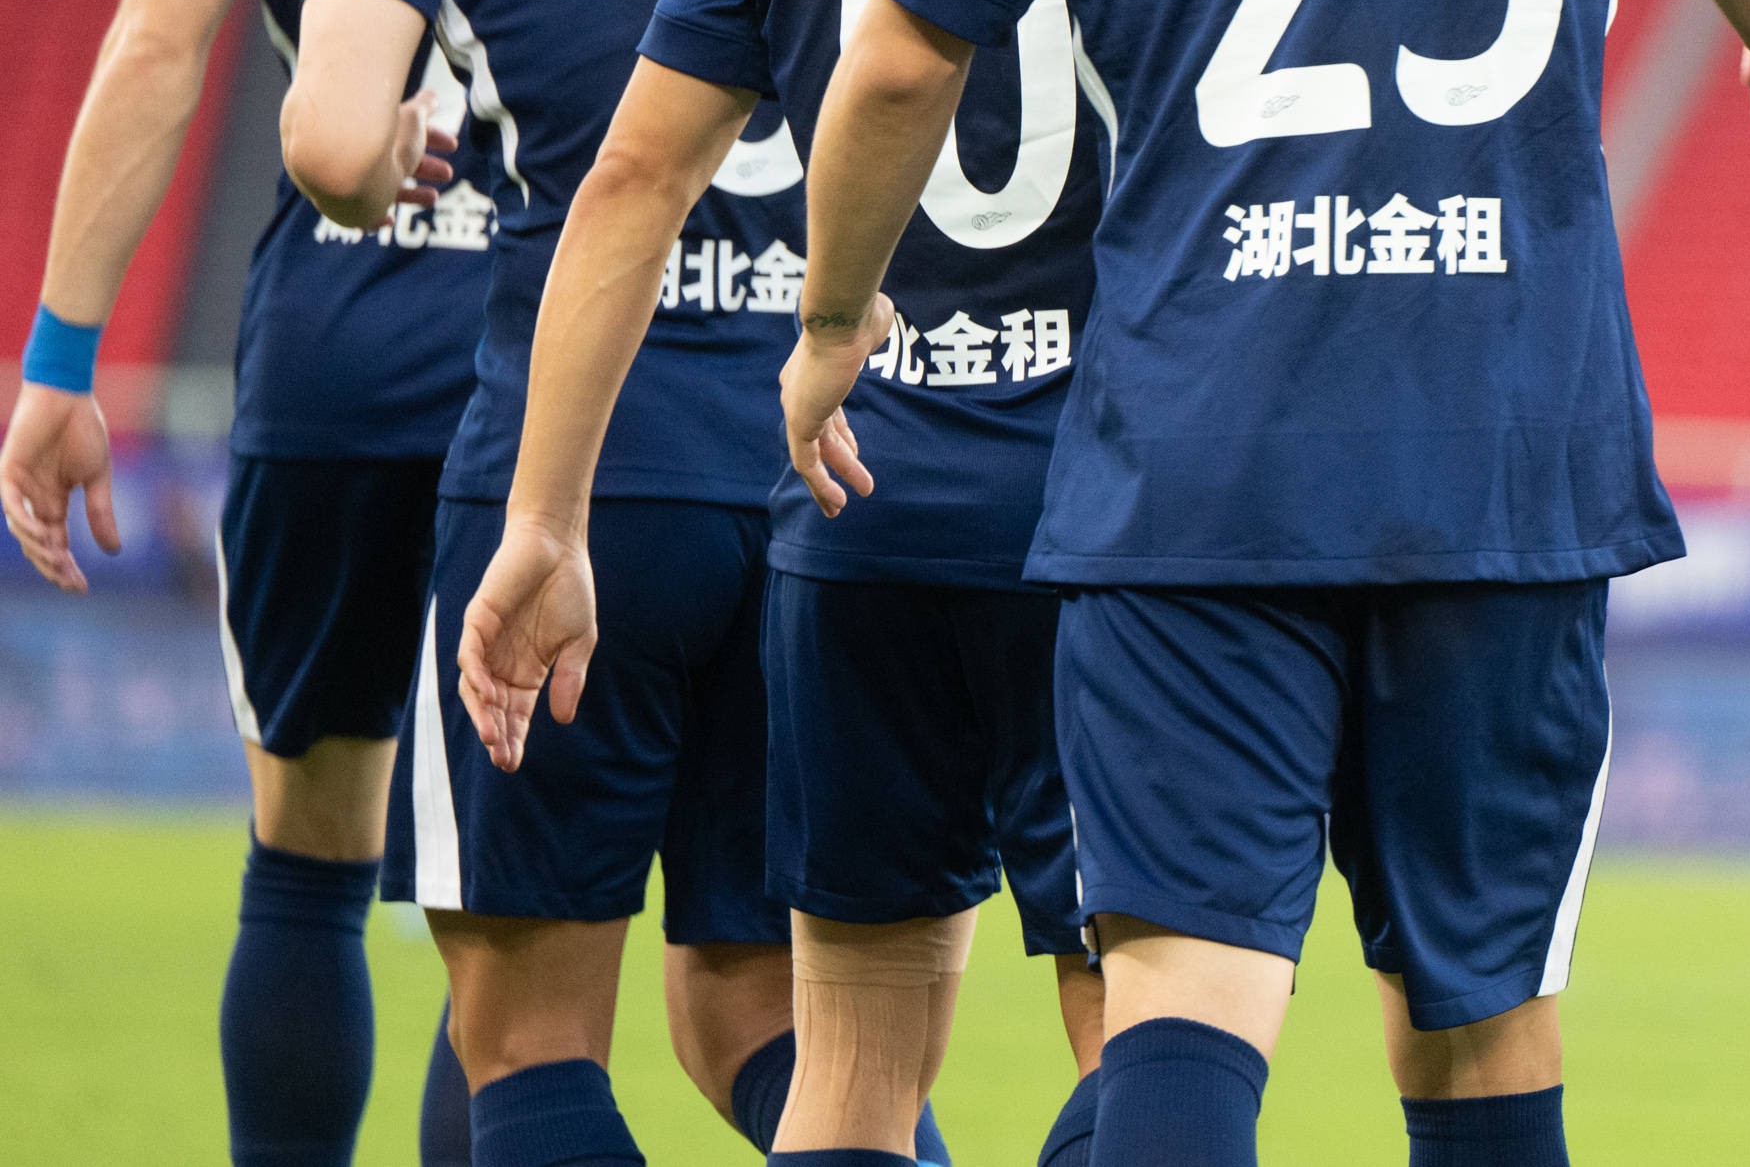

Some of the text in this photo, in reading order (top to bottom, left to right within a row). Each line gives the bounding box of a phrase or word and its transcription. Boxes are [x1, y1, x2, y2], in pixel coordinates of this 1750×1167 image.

[1223, 192, 1508, 282] 湖北金租
[860, 308, 1072, 386] 北金租
